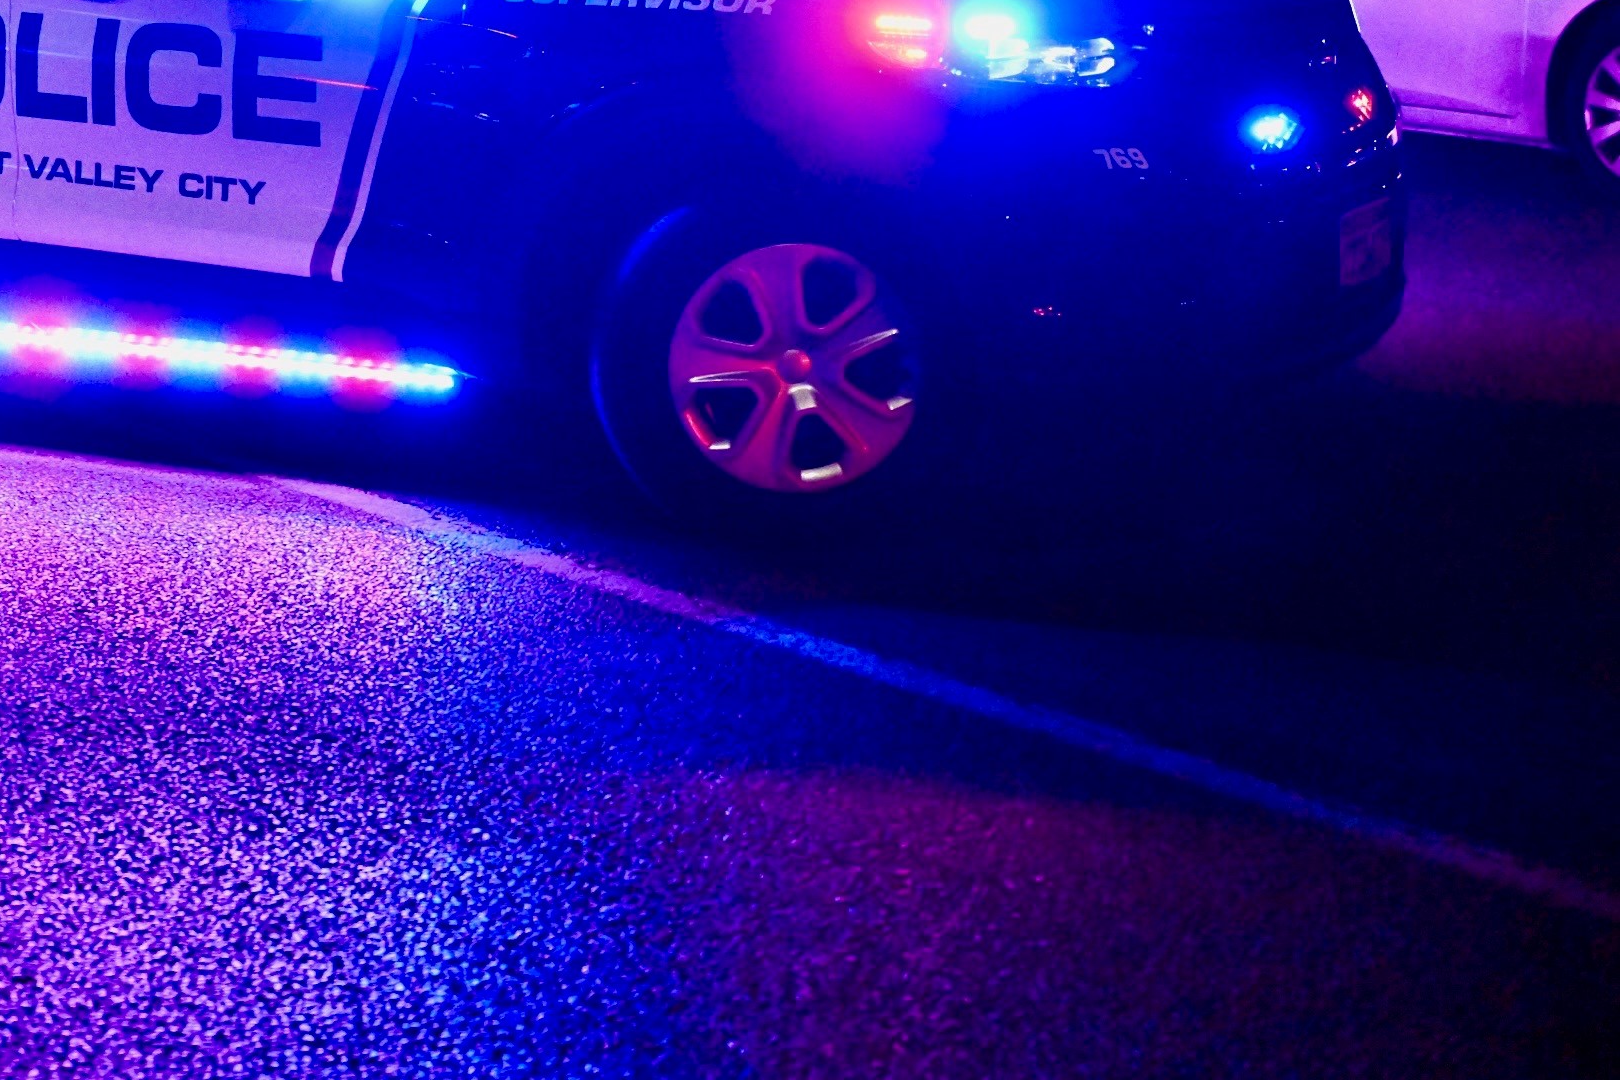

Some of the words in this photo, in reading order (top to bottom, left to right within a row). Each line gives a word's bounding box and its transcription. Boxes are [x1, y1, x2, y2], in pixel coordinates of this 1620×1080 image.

[1092, 147, 1149, 170] 769
[23, 153, 164, 193] VALLEY
[178, 172, 267, 205] CITY
